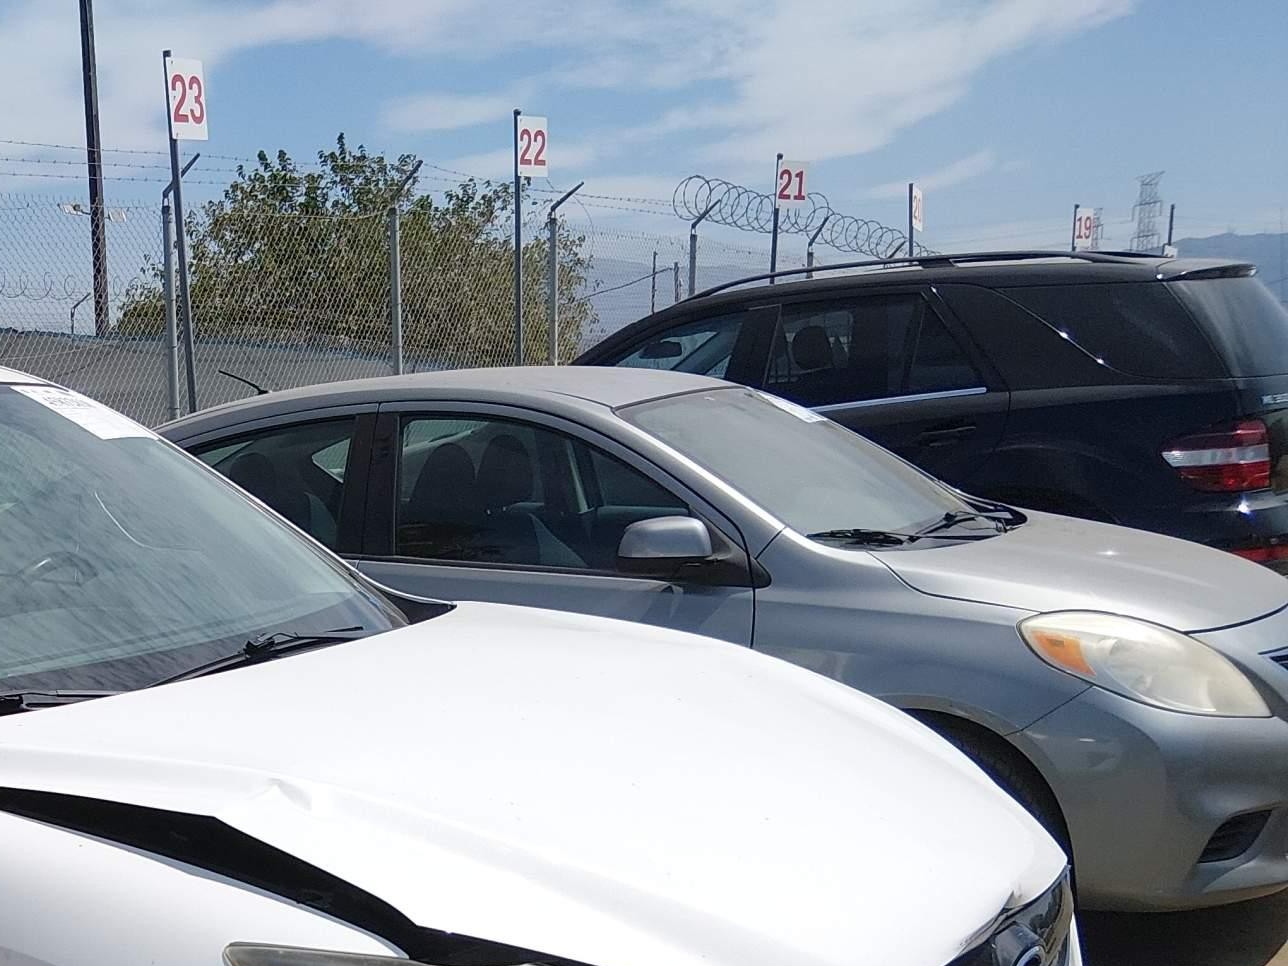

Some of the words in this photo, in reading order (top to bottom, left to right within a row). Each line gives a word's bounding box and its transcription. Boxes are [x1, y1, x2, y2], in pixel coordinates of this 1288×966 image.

[171, 73, 205, 125] 23
[520, 128, 546, 166] 22
[778, 169, 805, 200] 21
[1075, 216, 1092, 239] 19
